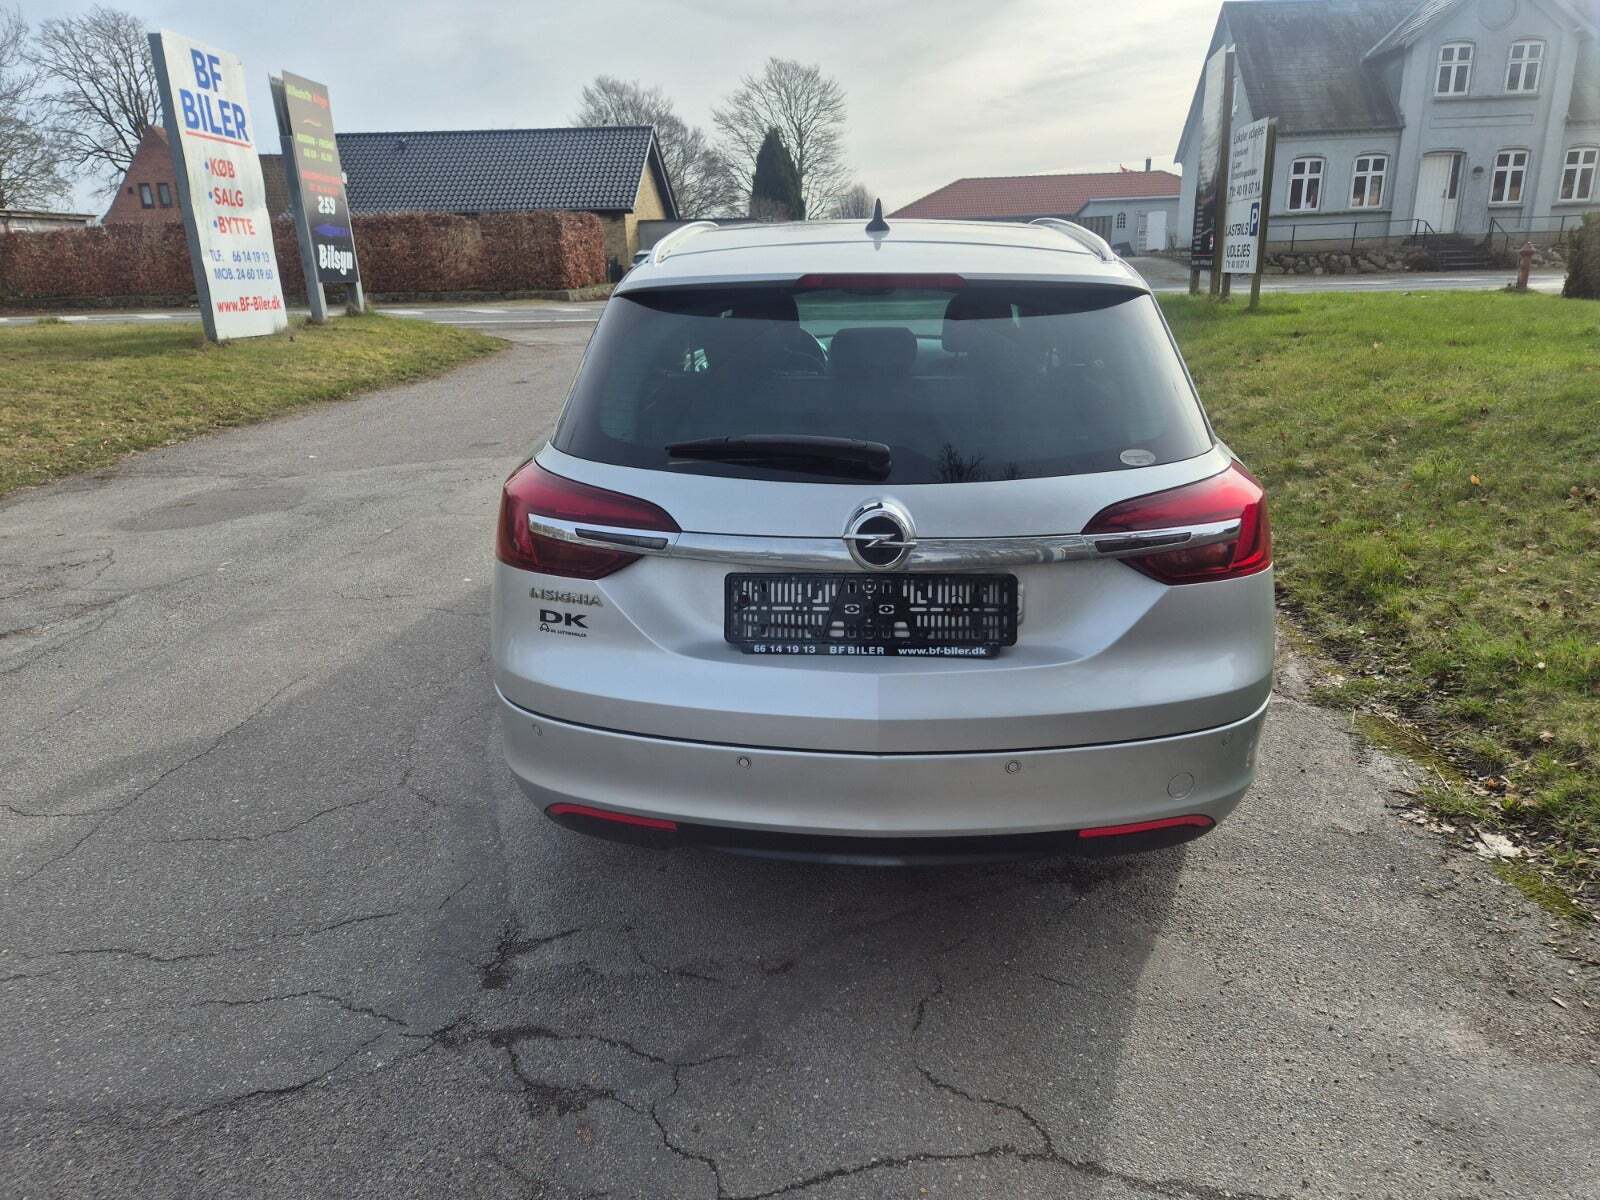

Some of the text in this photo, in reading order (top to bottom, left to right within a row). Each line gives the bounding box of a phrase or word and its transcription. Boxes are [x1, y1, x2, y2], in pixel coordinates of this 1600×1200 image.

[190, 48, 222, 92] BF
[179, 88, 249, 141] BILER
[209, 158, 235, 178] KØB
[214, 187, 244, 207] SALG
[318, 195, 336, 215] 259
[218, 216, 256, 235] BYTTE
[242, 251, 251, 263] 14
[236, 268, 246, 280] 24
[216, 295, 281, 312] www.BF-Biler.dk
[529, 587, 603, 607] INSIGNIA
[540, 609, 589, 629] DK
[753, 645, 766, 653] 66
[769, 645, 782, 653] 14
[786, 645, 799, 653] 19
[802, 645, 816, 653] 13
[898, 646, 986, 656] www.bf-biler.dk
